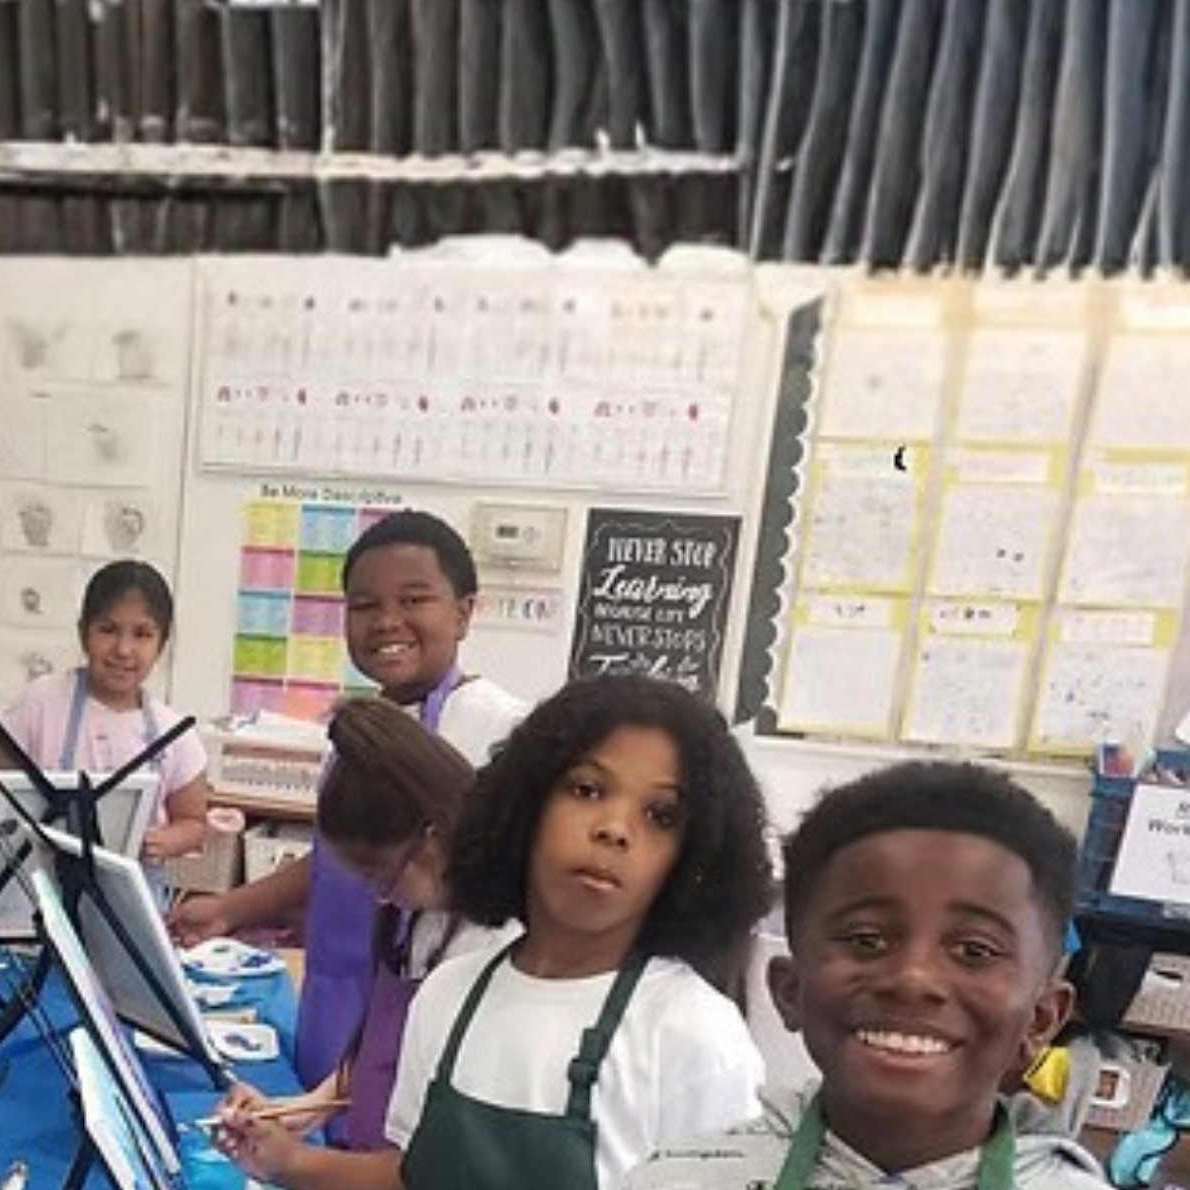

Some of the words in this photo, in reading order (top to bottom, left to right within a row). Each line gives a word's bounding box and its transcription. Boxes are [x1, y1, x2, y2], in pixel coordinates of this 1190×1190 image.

[608, 537, 666, 565] NEVER
[670, 540, 717, 569] STOP
[593, 564, 712, 619] Learning
